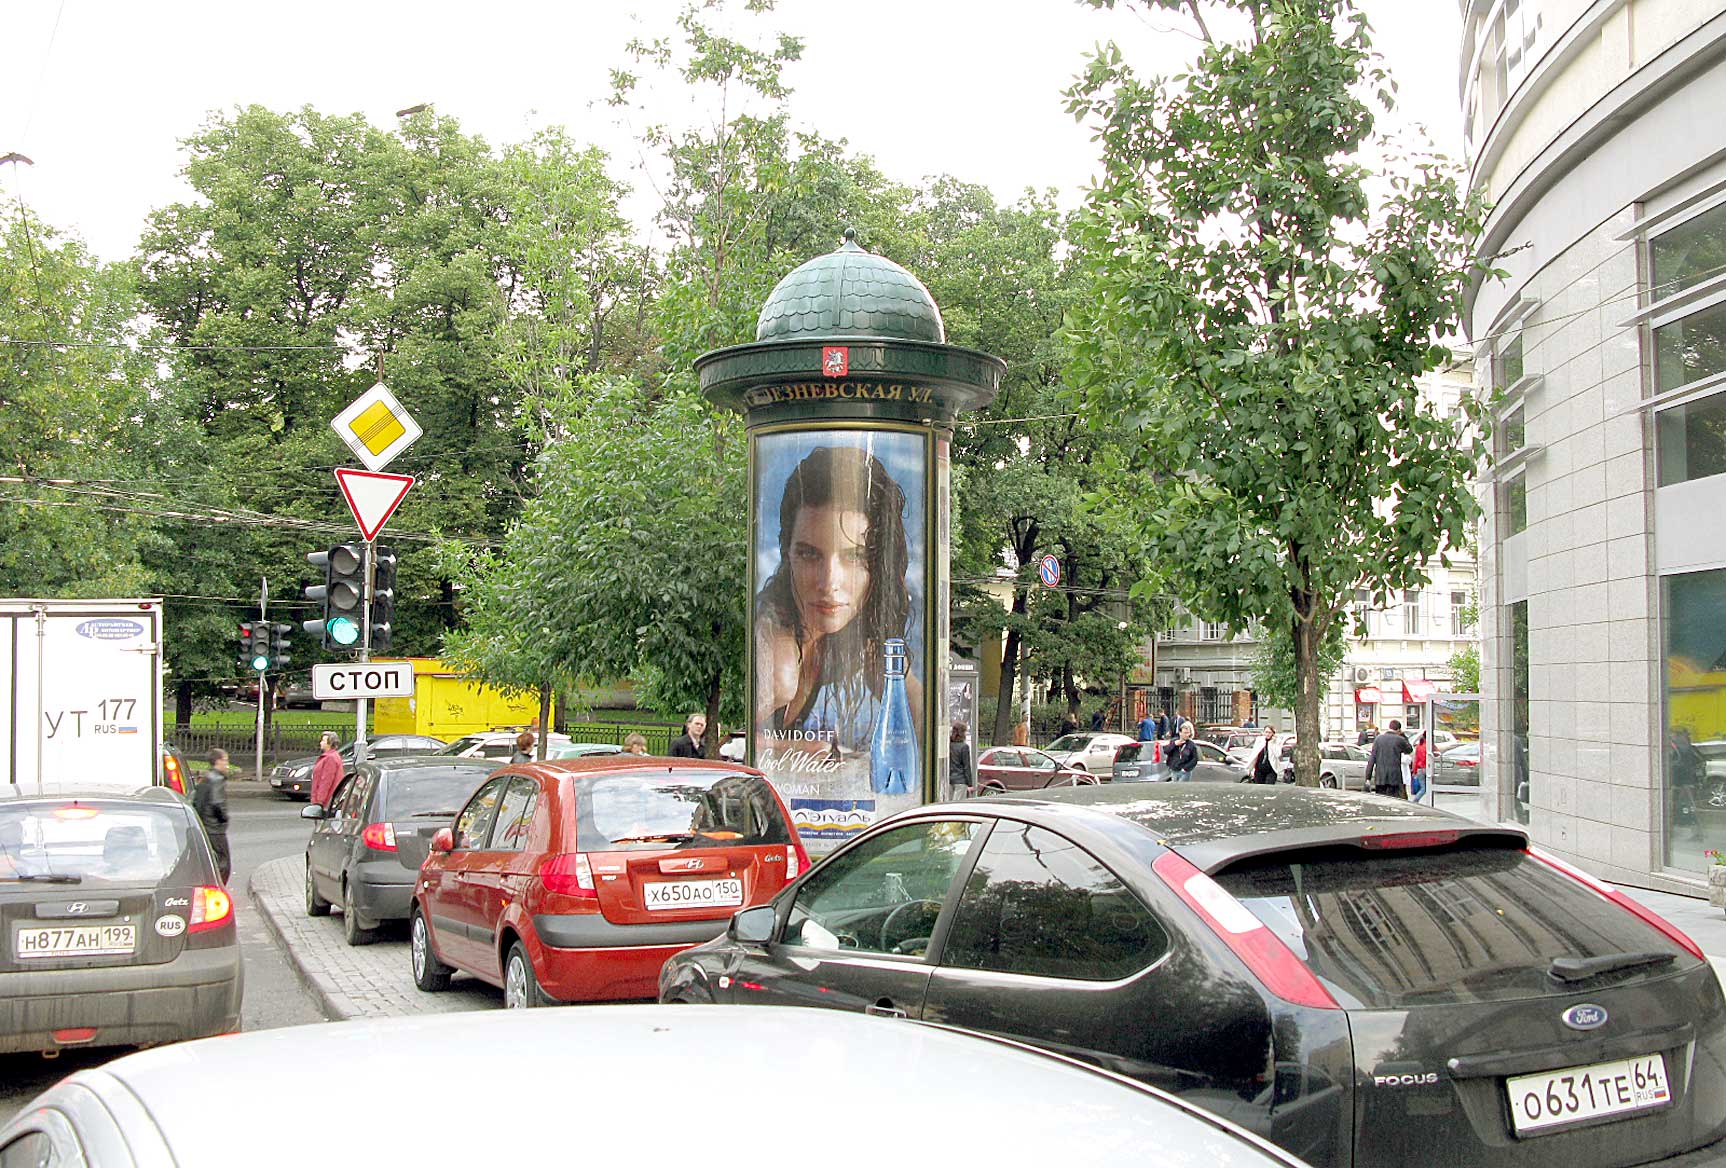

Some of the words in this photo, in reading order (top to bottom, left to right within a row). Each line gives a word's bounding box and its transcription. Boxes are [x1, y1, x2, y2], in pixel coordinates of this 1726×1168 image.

[330, 671, 399, 690] СТОП
[97, 698, 137, 721] 177
[94, 724, 117, 734] RUS
[763, 728, 835, 742] DAVIDOFF
[758, 747, 792, 772] Cool
[789, 749, 847, 773] Water
[715, 881, 738, 894] 150
[164, 897, 189, 907] Getz
[160, 921, 181, 930] RUS
[103, 927, 131, 942] 199
[1575, 1008, 1600, 1025] Ford
[1374, 1073, 1439, 1087] FOCUS
[1634, 1060, 1660, 1091] 64
[1636, 1090, 1655, 1101] RUS
